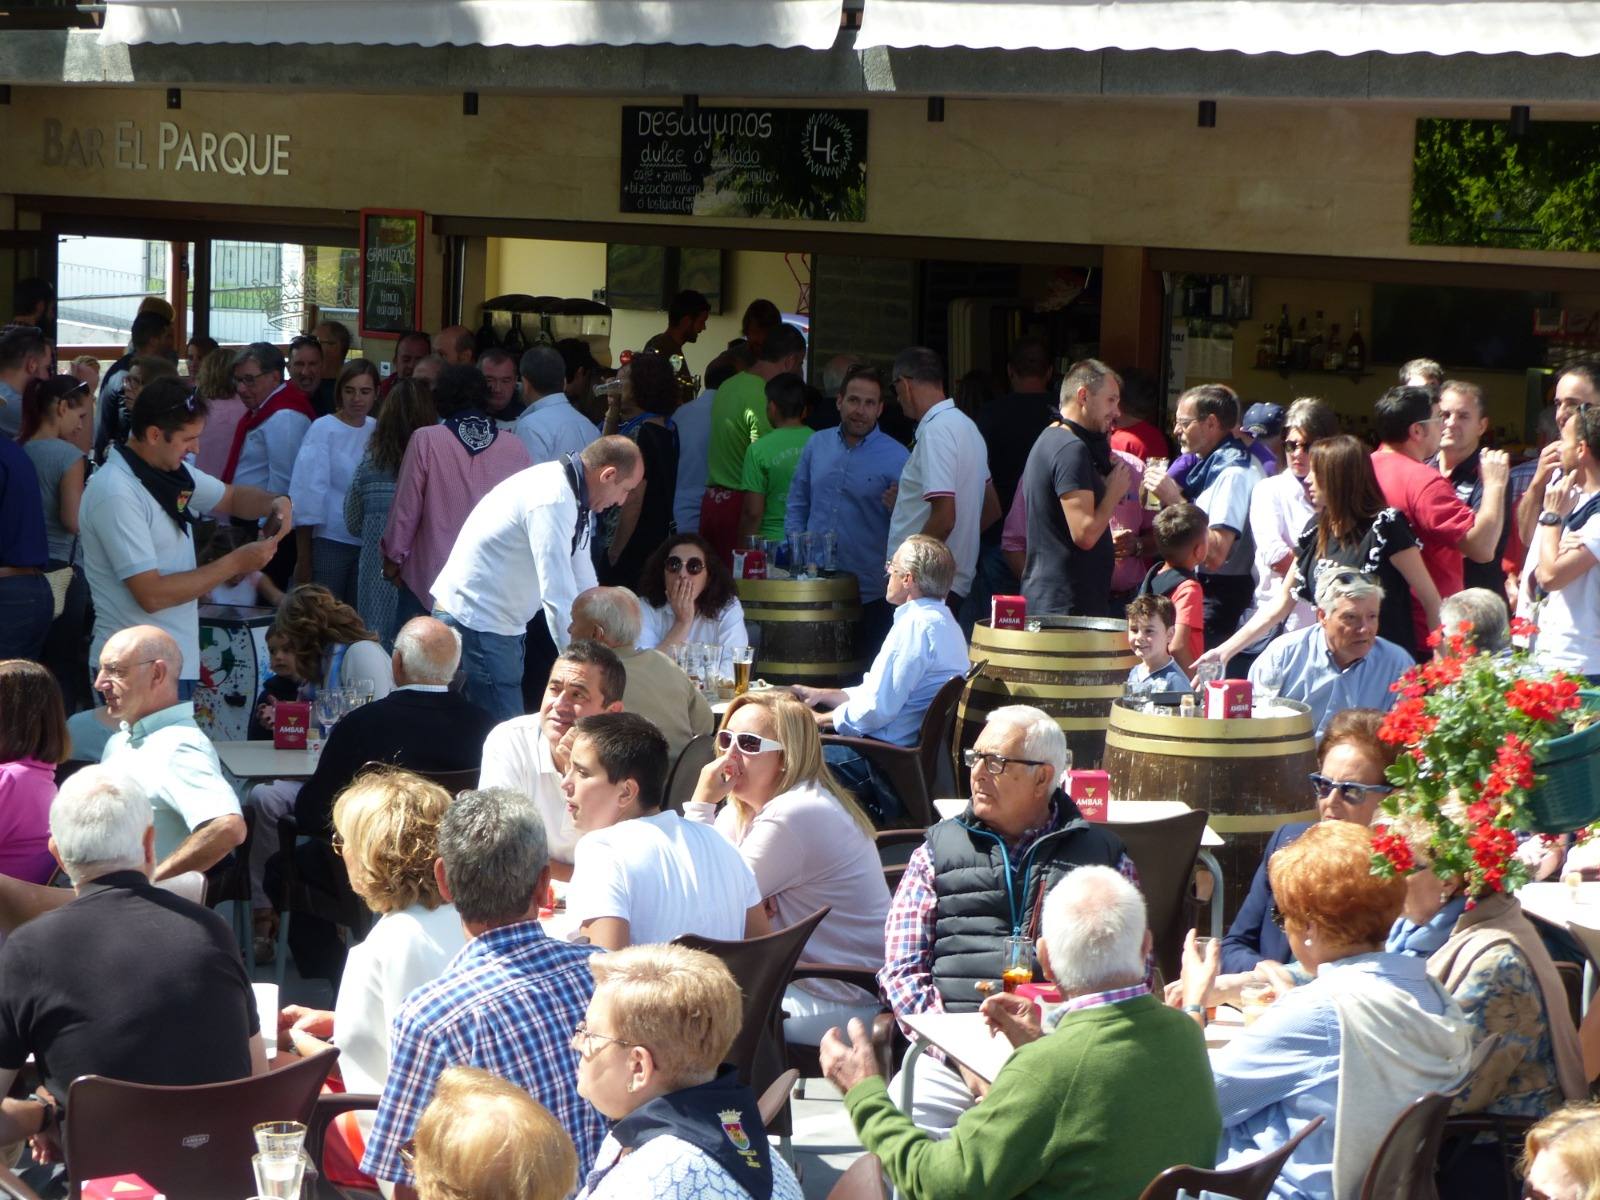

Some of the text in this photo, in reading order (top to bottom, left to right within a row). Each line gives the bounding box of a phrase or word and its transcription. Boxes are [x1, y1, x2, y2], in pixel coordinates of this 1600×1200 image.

[158, 121, 290, 176] PARQUE
[640, 140, 684, 163] dulce
[279, 726, 305, 735] AMBAR
[1076, 798, 1104, 807] AMBAR
